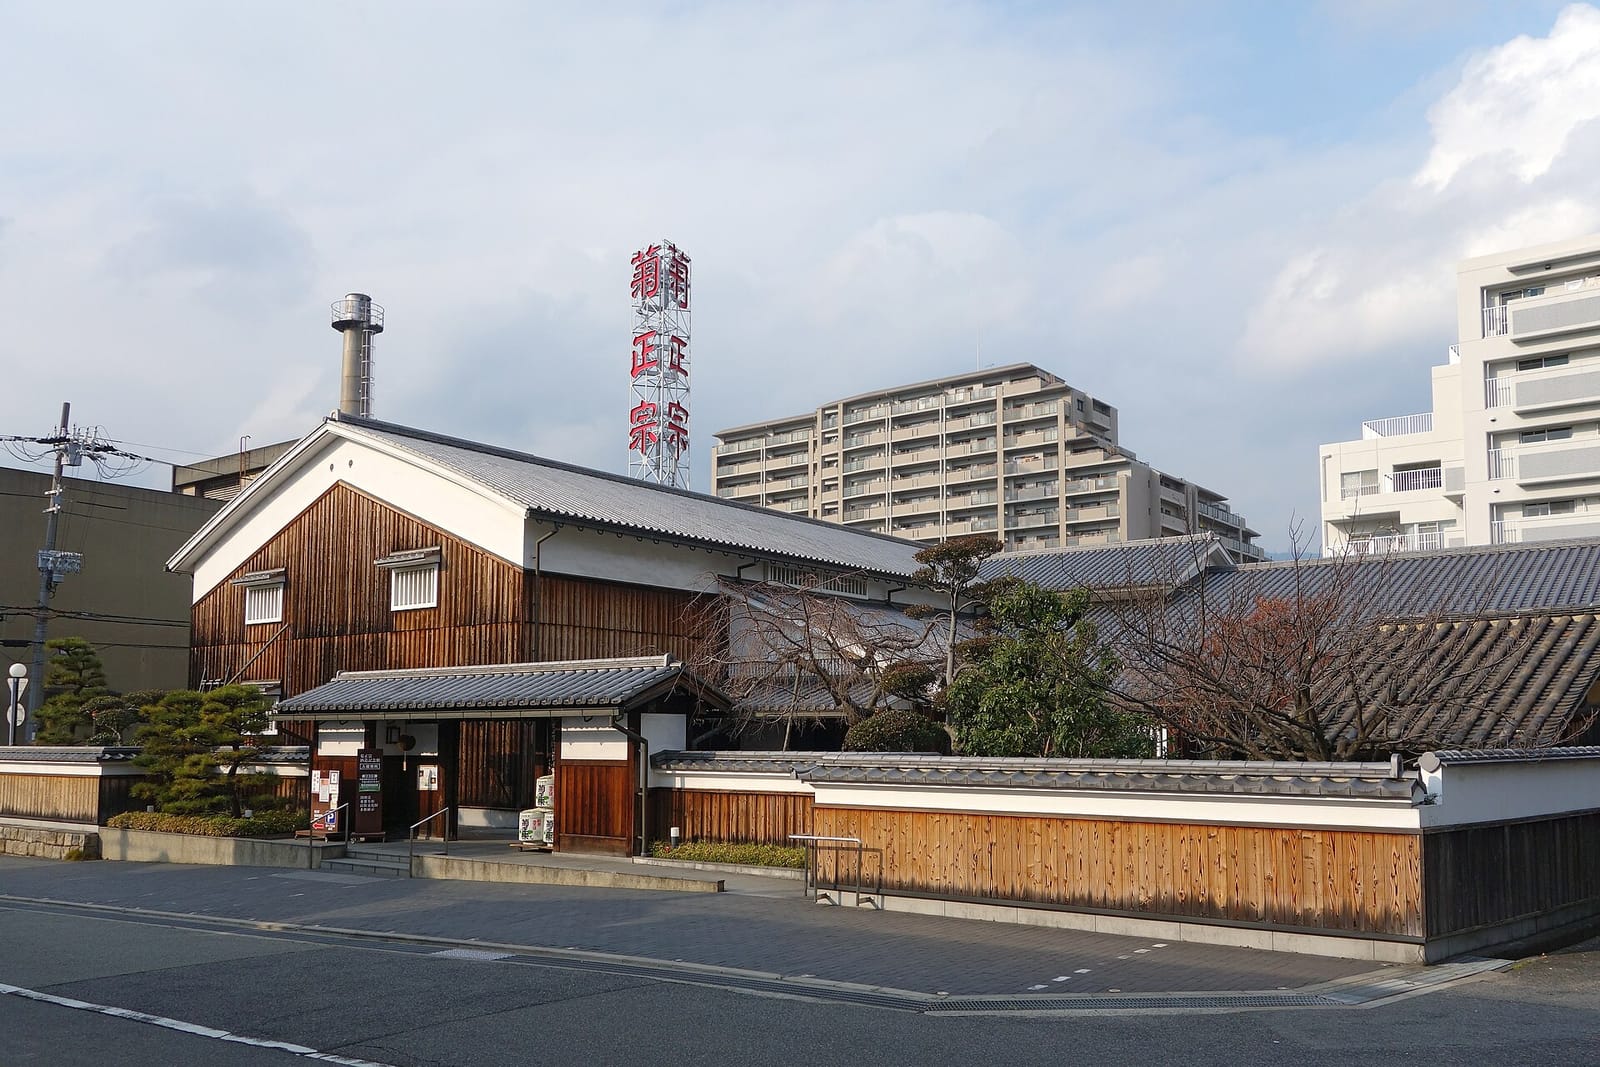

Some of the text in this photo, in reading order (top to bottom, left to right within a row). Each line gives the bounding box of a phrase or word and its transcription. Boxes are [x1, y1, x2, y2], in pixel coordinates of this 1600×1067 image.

[629, 244, 662, 456] 菊正宗
[667, 243, 690, 461] 菊正宗
[327, 813, 334, 823] P
